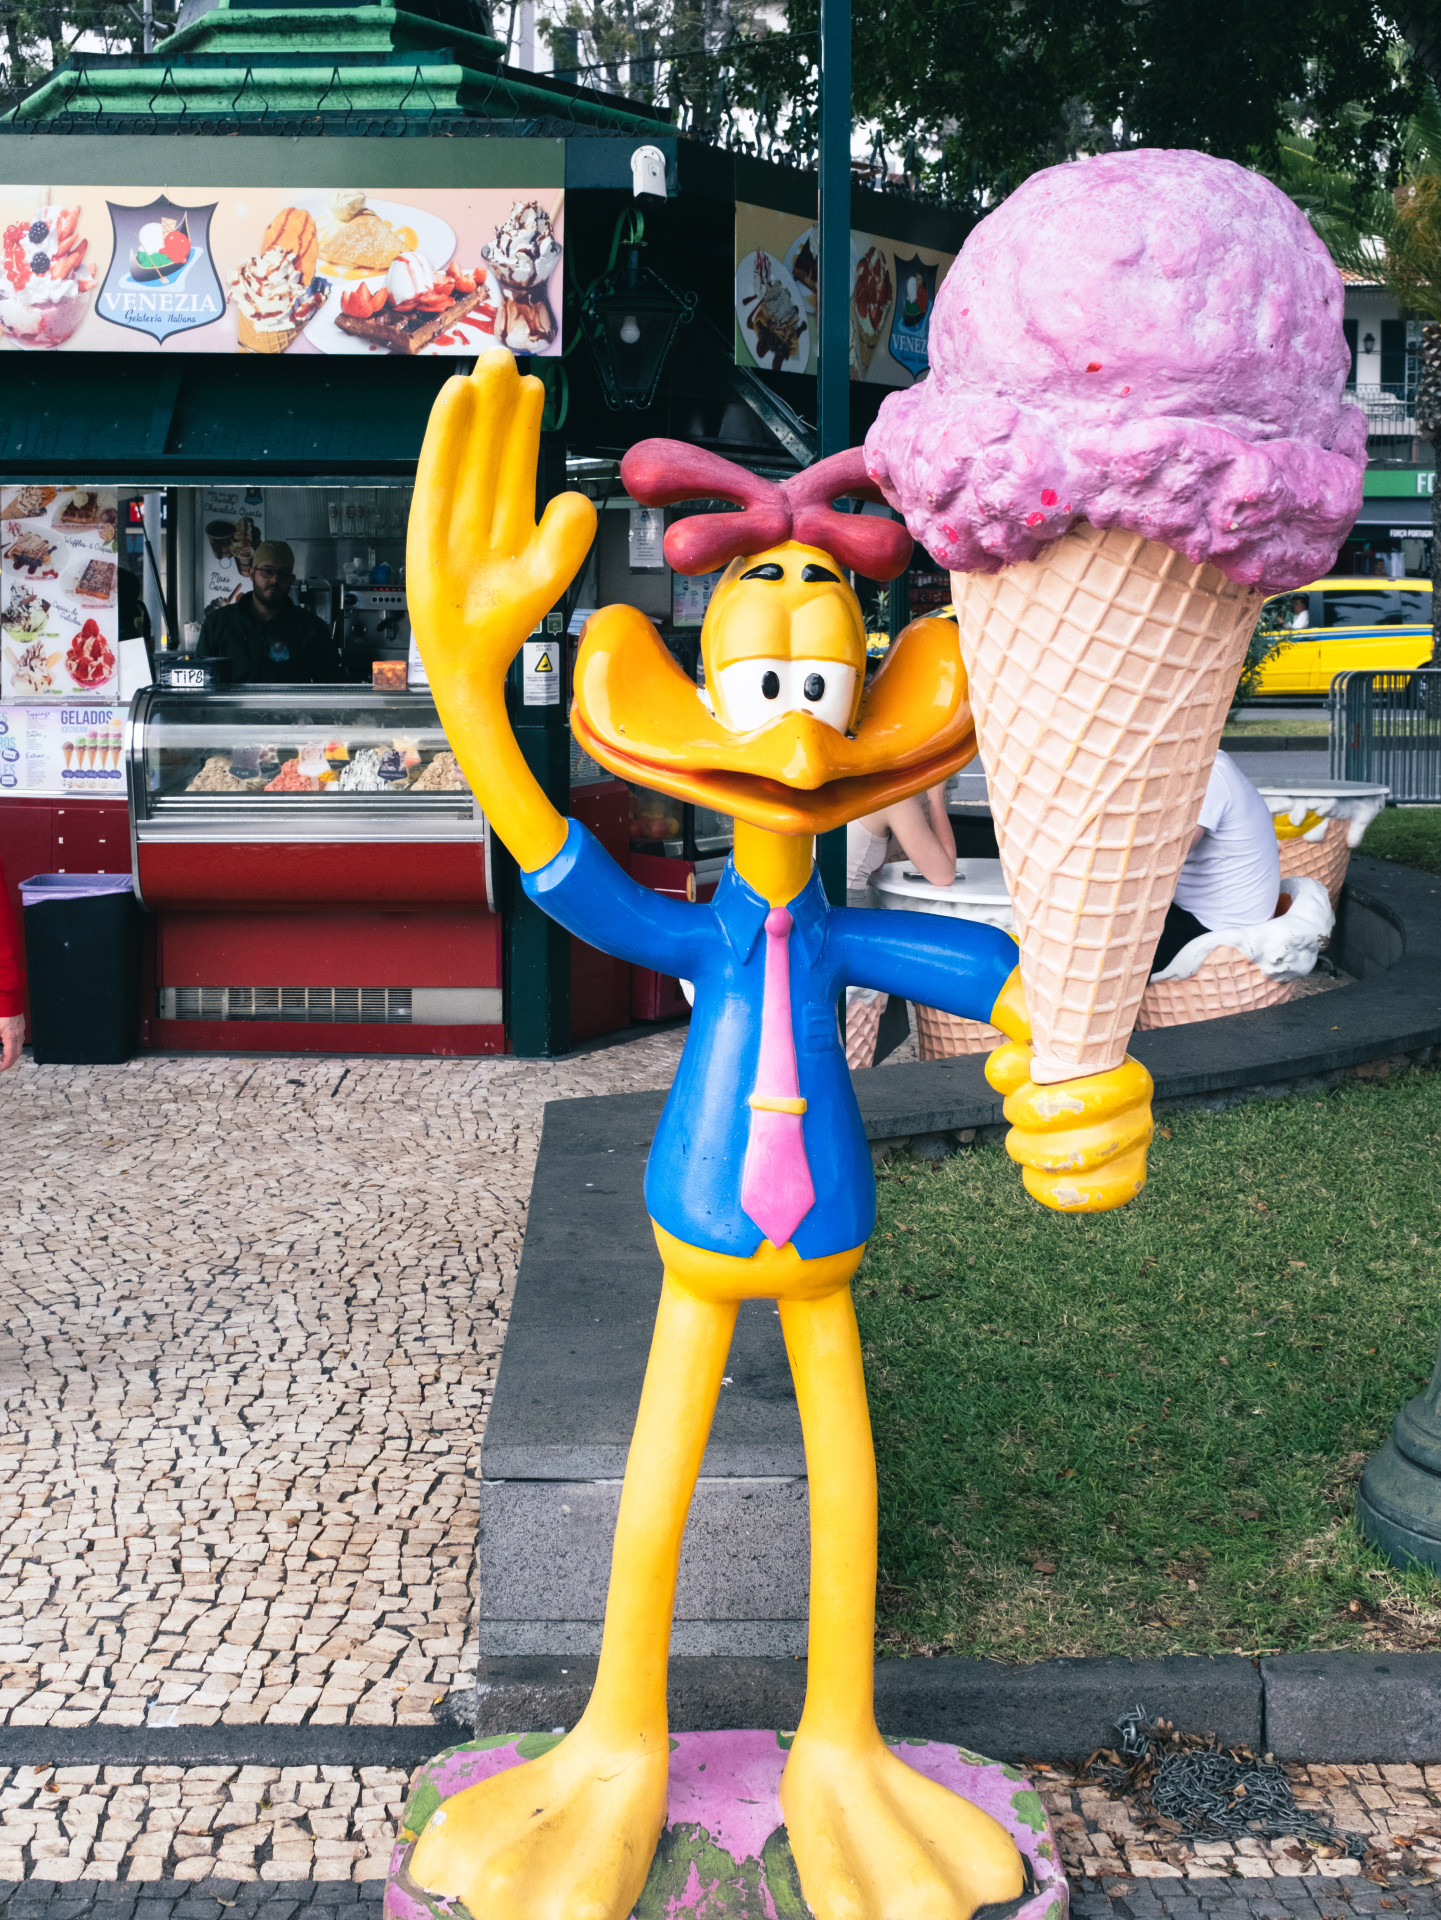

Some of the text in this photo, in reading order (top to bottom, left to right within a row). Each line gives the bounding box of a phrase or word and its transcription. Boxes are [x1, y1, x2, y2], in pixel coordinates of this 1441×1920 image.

[104, 293, 217, 312] VENEZIA
[124, 309, 196, 324] Gelateria italiana
[892, 333, 929, 355] VENEZ
[203, 502, 263, 518] Chocolate Quente
[64, 536, 87, 548] Waffles
[61, 710, 113, 724] GELADOS
